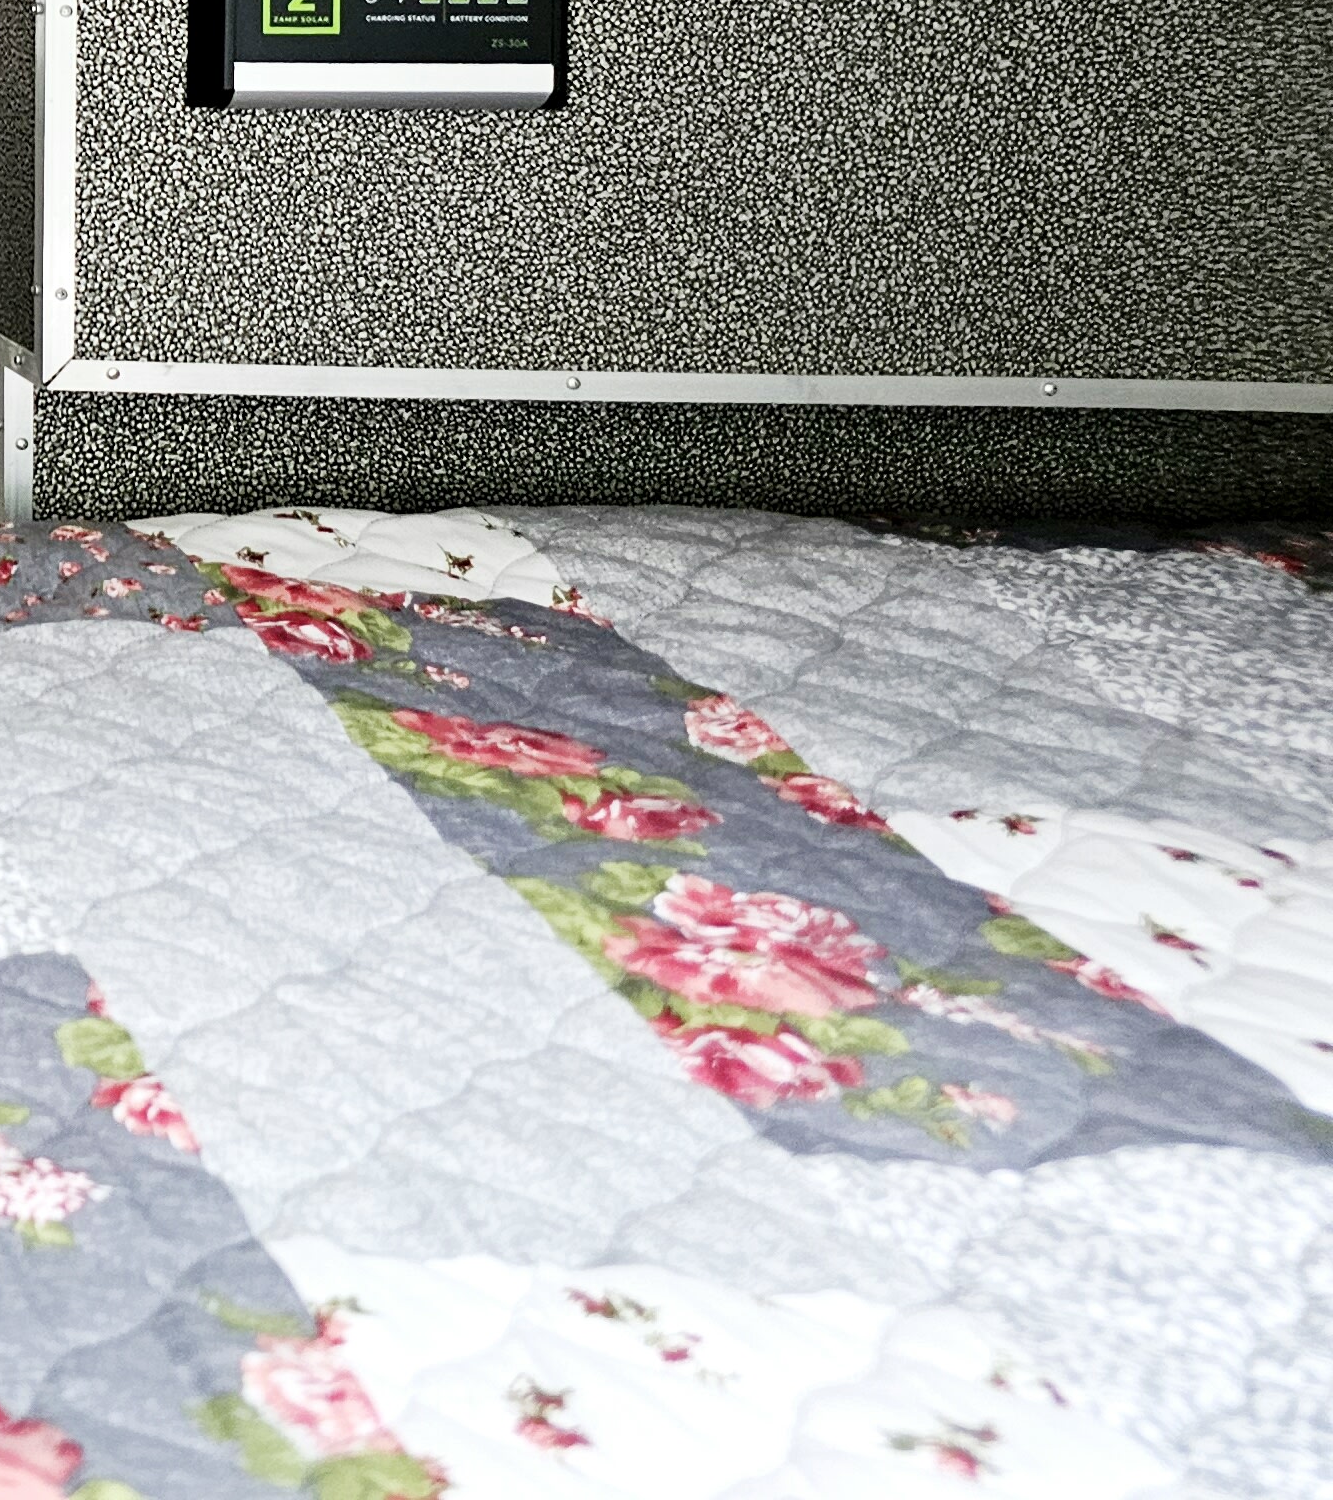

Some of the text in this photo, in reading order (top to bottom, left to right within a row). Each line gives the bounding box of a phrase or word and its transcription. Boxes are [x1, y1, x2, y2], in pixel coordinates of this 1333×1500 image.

[365, 14, 436, 23] CHARGING STATUS
[449, 15, 529, 23] BATTERY CONDITION
